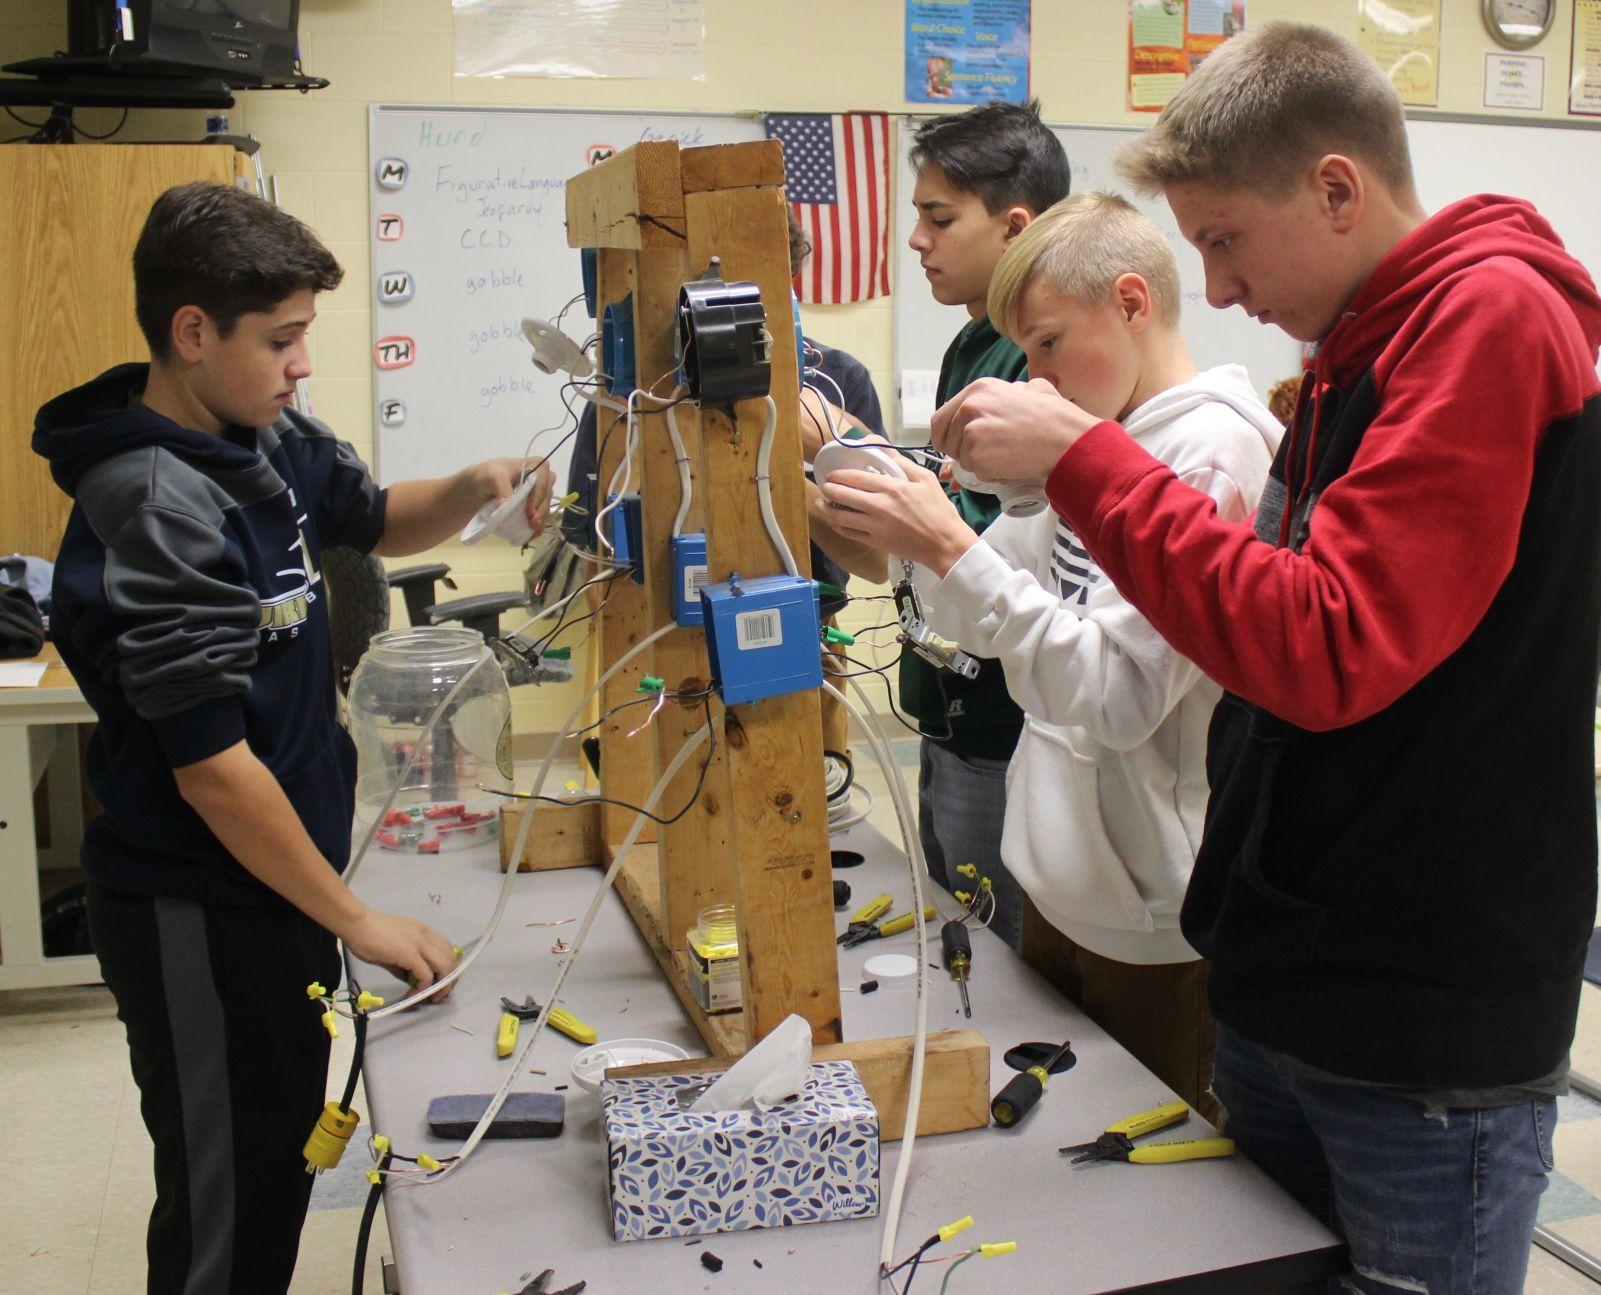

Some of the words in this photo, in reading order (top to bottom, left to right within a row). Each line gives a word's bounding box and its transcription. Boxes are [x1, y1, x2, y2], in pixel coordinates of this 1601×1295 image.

[419, 120, 488, 149] Hurd
[381, 163, 404, 182] M
[519, 165, 565, 197] Langua
[380, 218, 399, 236] T
[384, 277, 407, 296] W
[466, 268, 525, 295] gobble
[380, 343, 410, 363] TH
[480, 376, 537, 407] gobble
[384, 402, 400, 421] F
